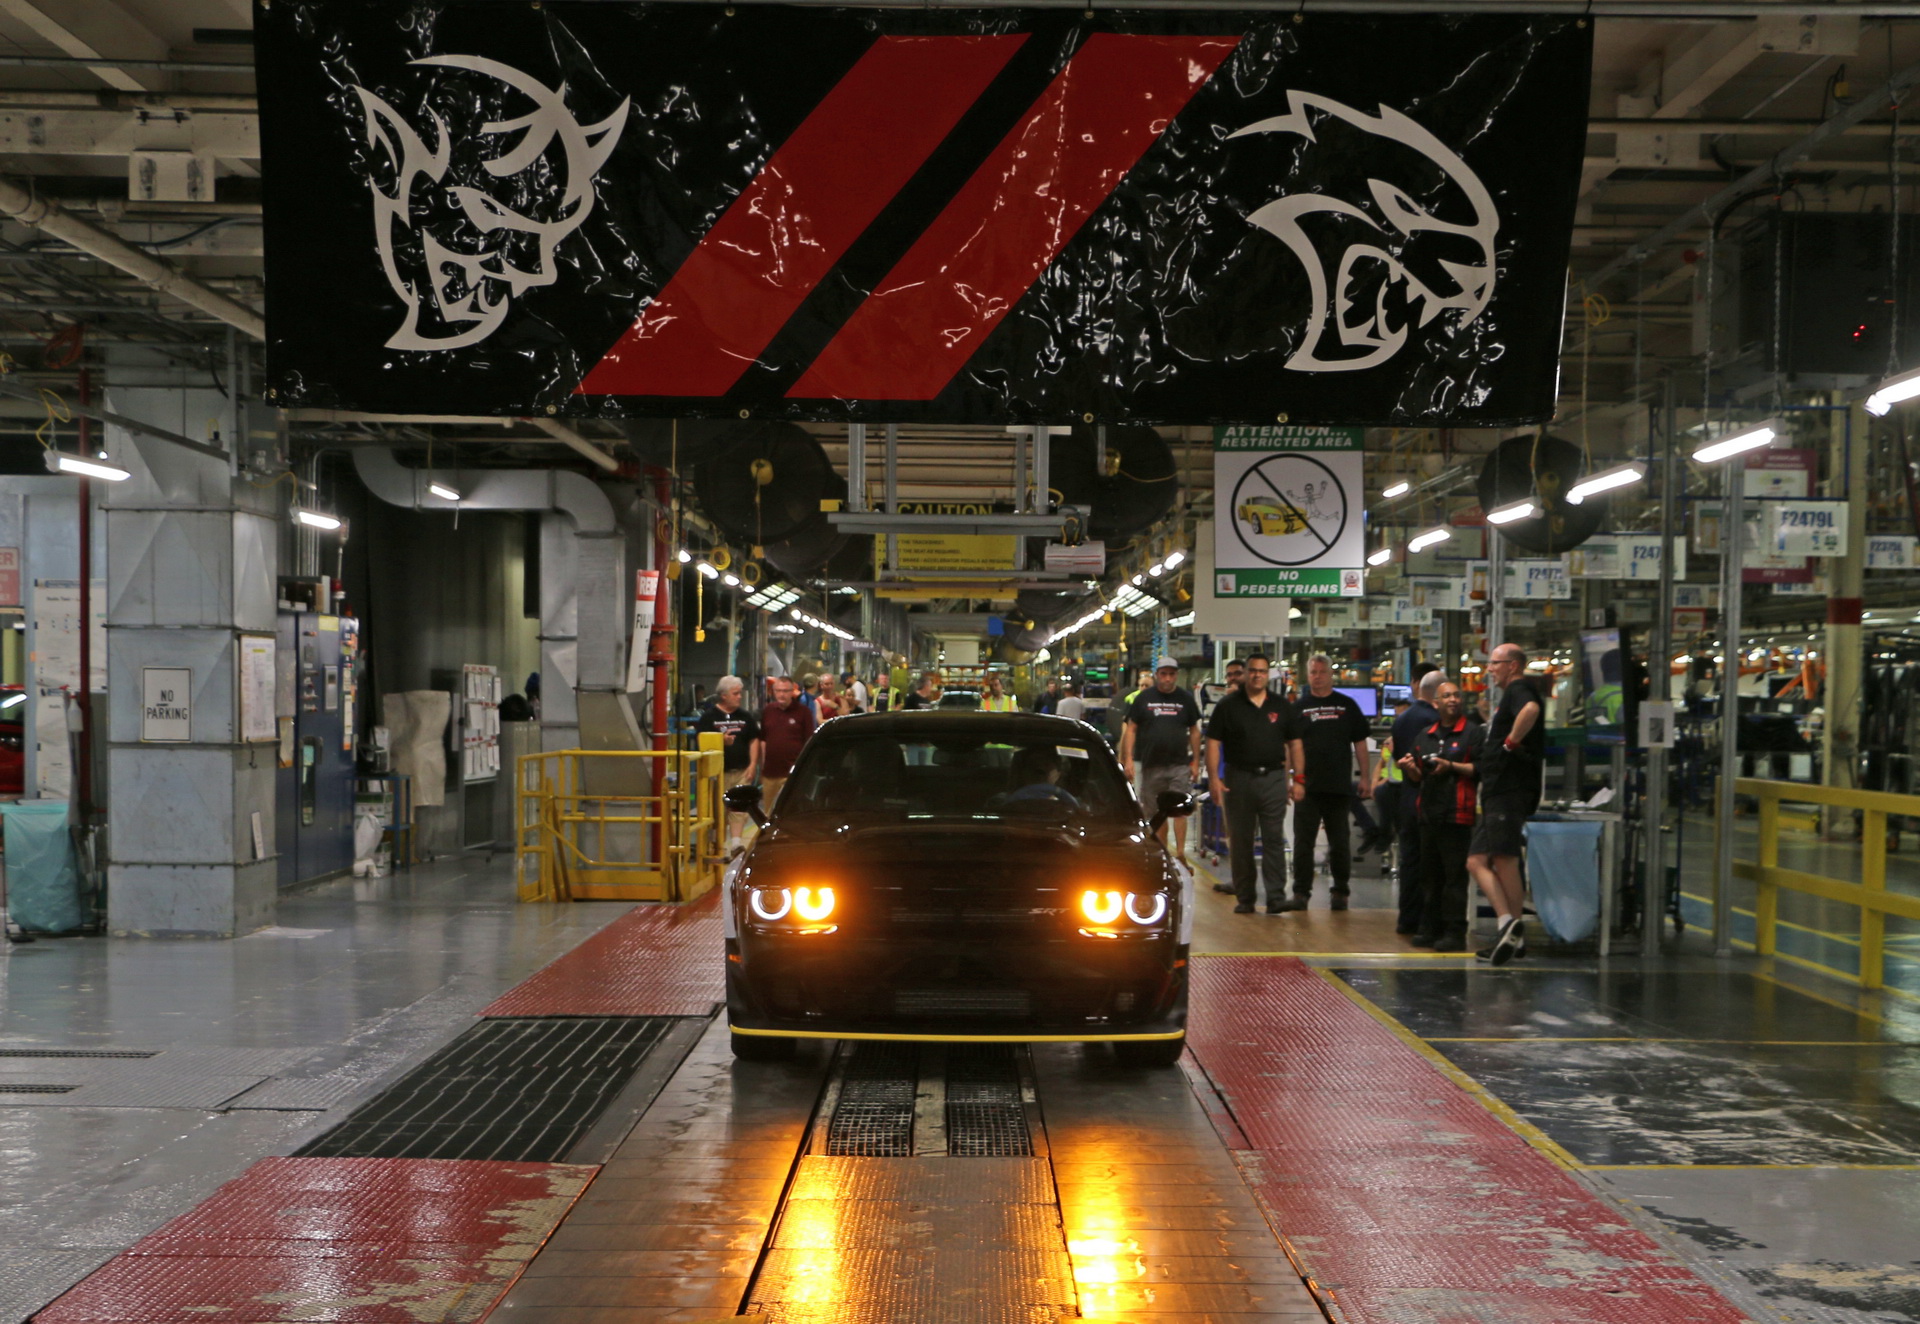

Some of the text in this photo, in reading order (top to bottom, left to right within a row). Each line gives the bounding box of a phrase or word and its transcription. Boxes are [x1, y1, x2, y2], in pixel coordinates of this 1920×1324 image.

[1225, 426, 1348, 437] ATTENTION...
[1220, 437, 1353, 448] RESTRICTED AREA
[1780, 510, 1834, 528] F2479L
[1278, 570, 1299, 580] NO
[1239, 584, 1338, 594] PEDESTRIANS
[161, 689, 174, 702] NO
[146, 706, 188, 720] PARKING
